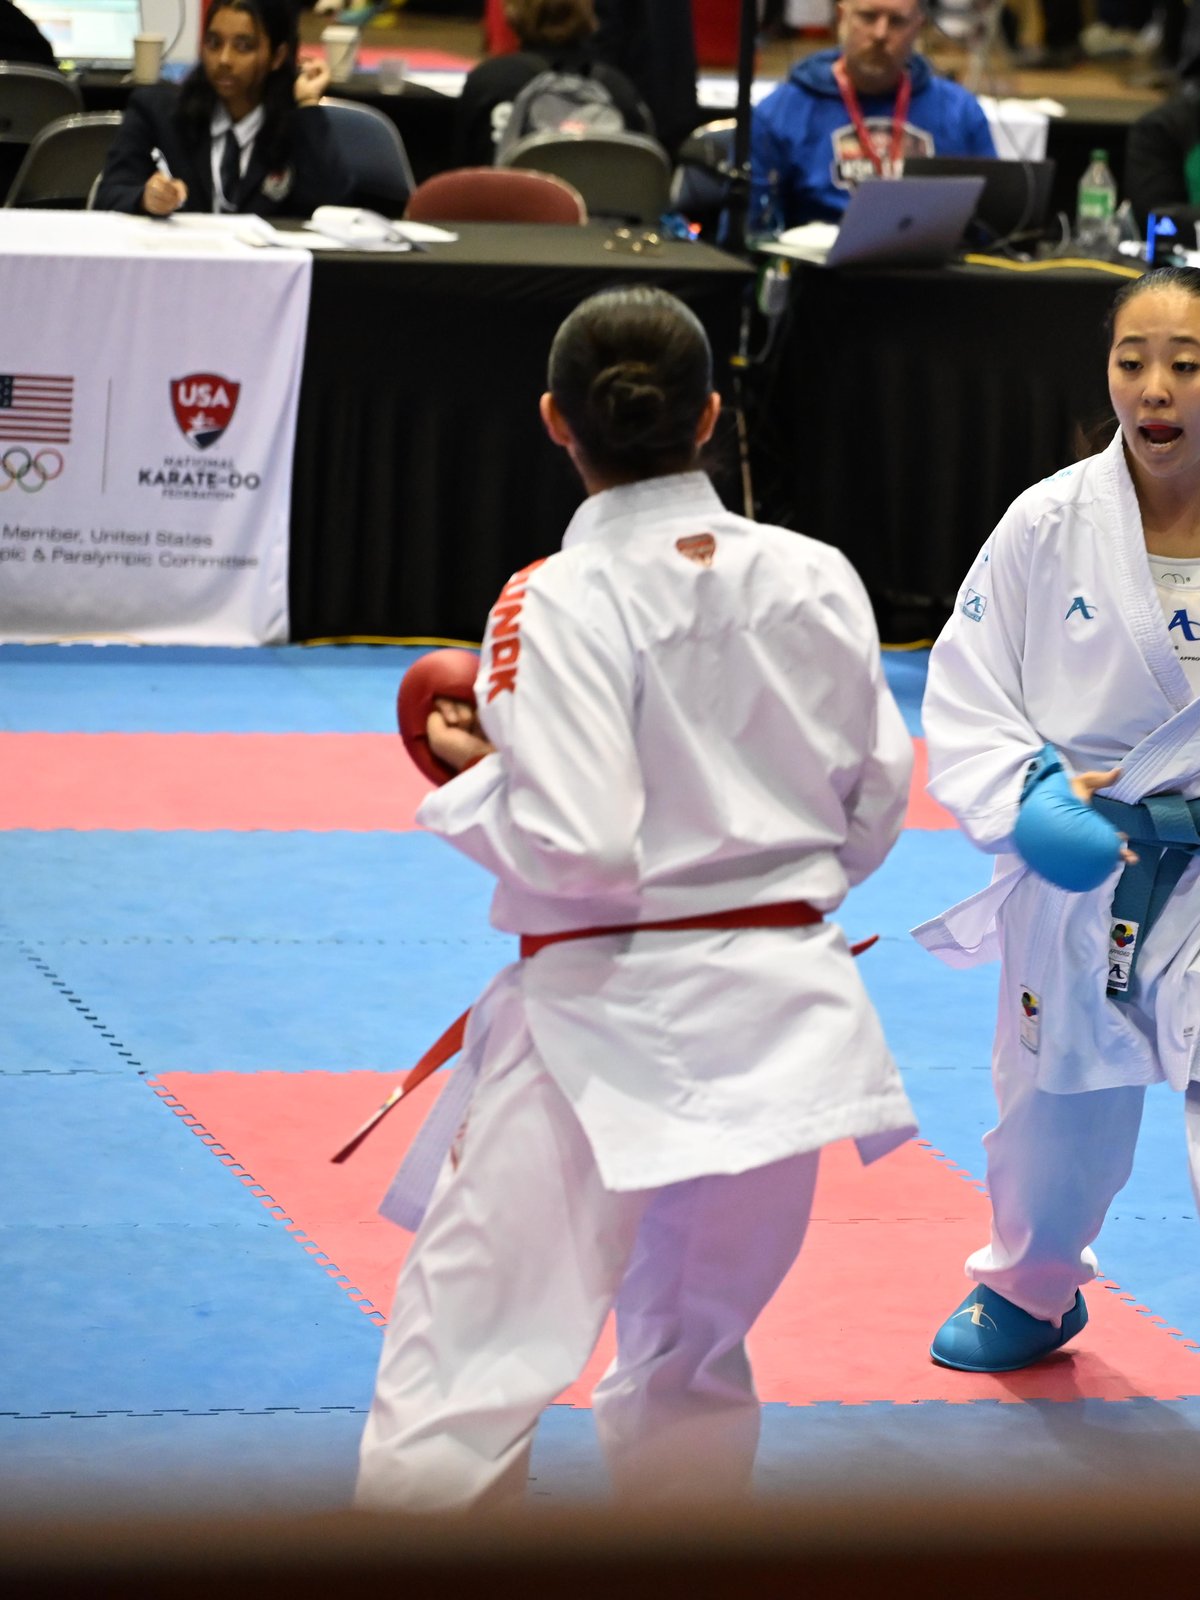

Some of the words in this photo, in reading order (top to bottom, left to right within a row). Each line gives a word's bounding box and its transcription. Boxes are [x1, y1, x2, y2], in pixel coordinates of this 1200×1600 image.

[178, 382, 230, 408] USA
[138, 467, 261, 490] KARATE-DO
[2, 523, 84, 544] Member,
[90, 528, 150, 545] United
[155, 529, 213, 547] States
[32, 546, 45, 563] &
[51, 546, 152, 569] Paralympic
[158, 550, 259, 569] Committee
